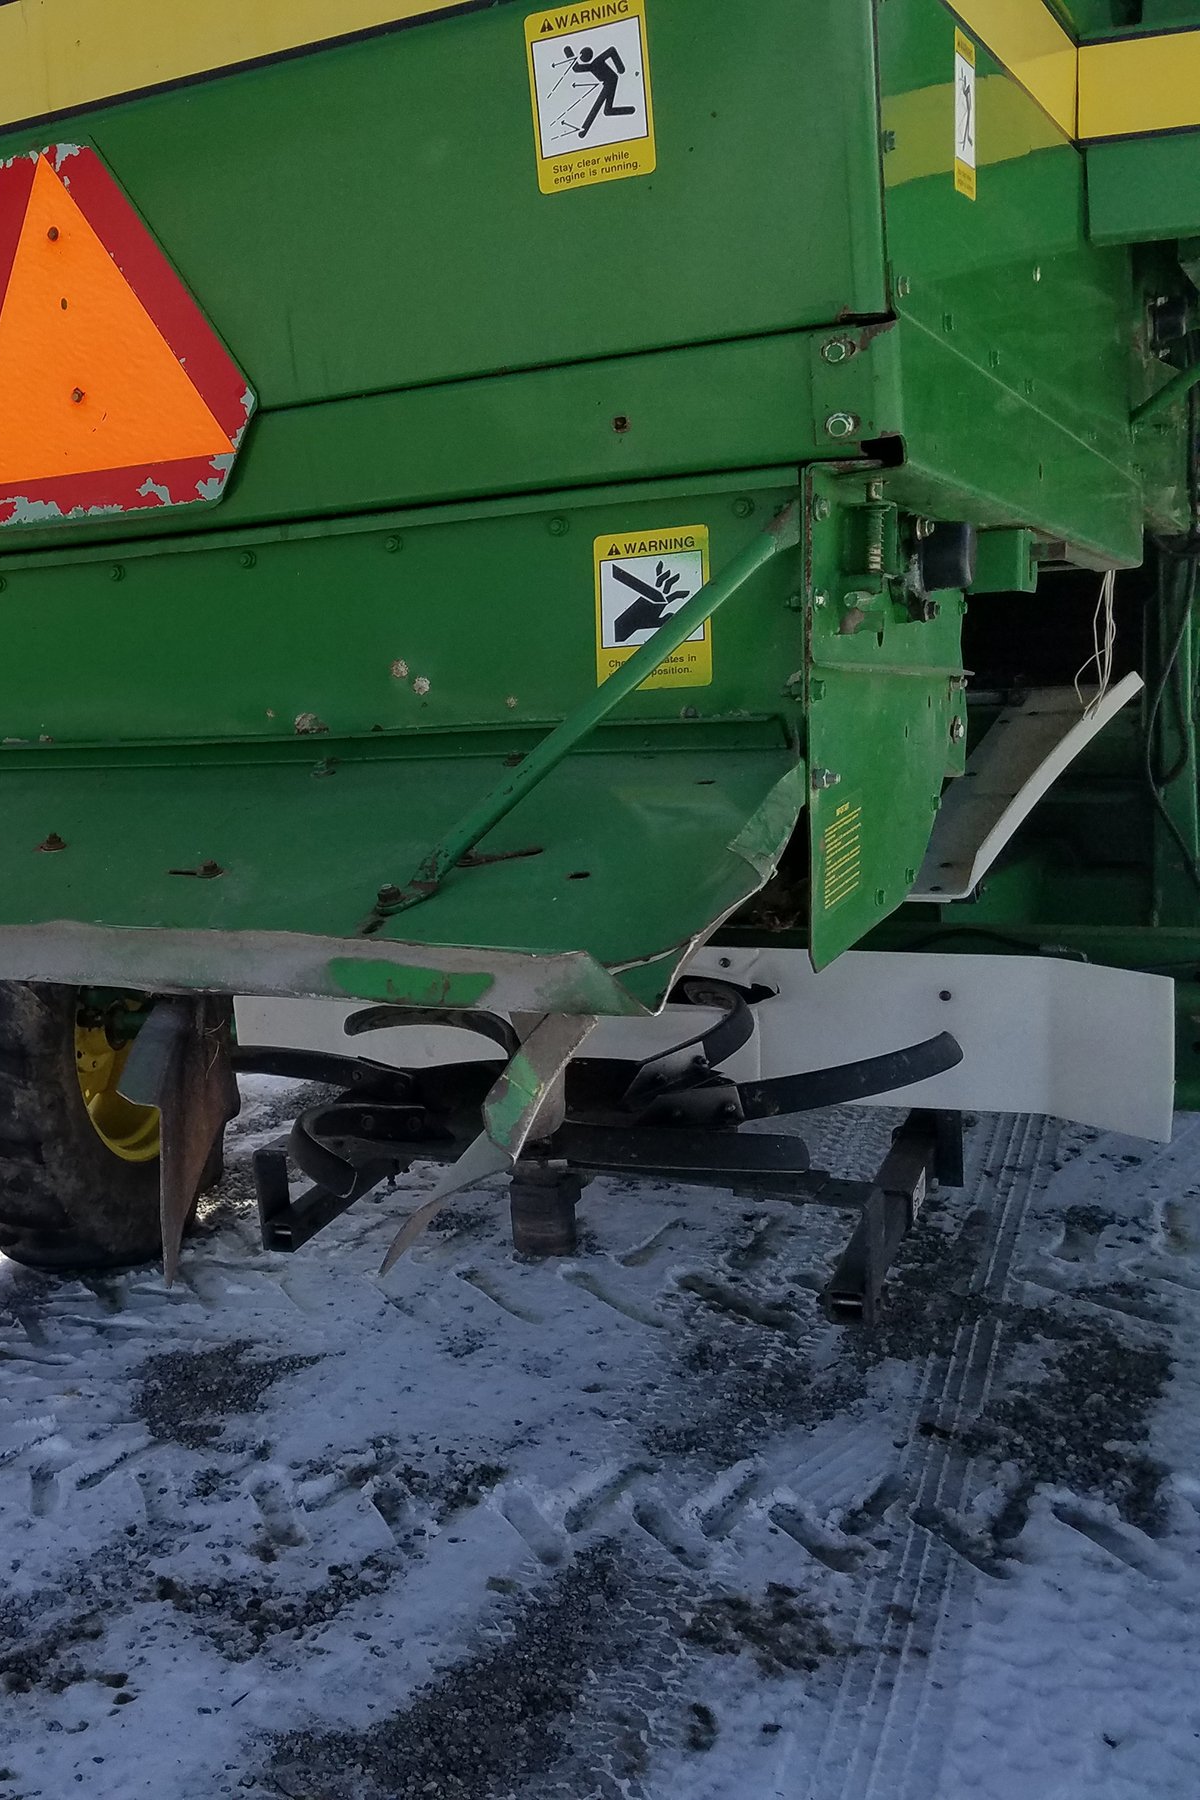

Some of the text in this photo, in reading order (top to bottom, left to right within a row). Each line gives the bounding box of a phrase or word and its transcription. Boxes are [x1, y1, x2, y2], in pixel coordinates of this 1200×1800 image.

[555, 0, 629, 29] WARNING
[553, 151, 629, 175] Stay clear while
[554, 161, 641, 185] engine is running.
[624, 536, 695, 555] WARNING
[688, 654, 697, 663] in
[652, 666, 692, 678] position.
